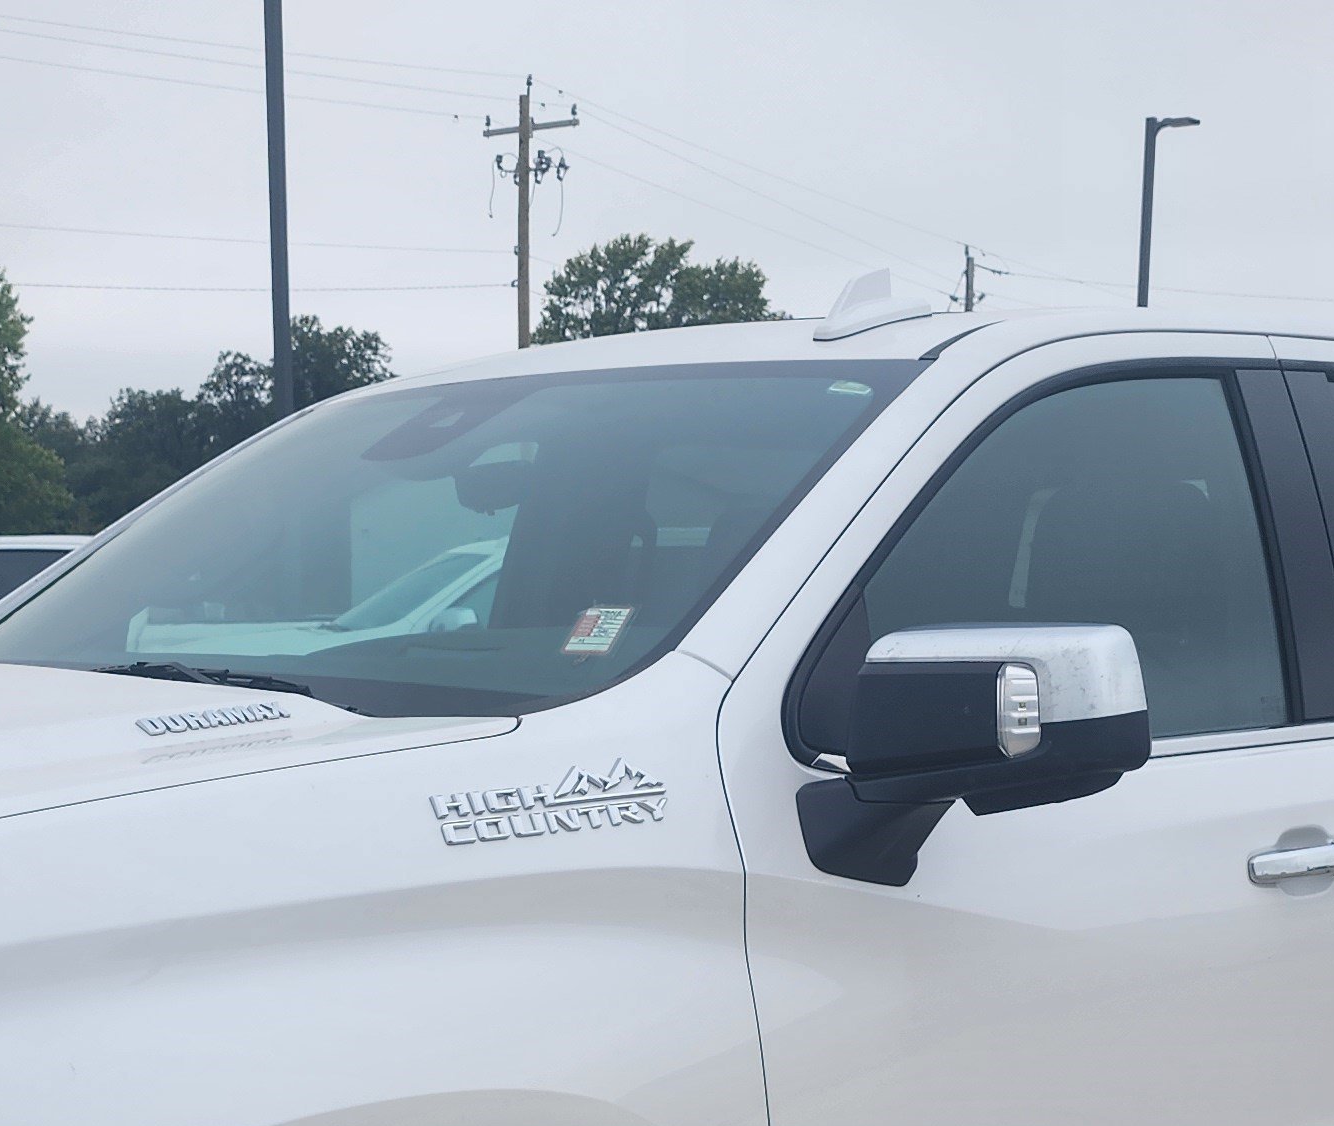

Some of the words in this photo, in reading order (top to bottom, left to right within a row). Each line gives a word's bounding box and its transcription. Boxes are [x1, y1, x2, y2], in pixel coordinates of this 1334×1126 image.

[135, 701, 291, 737] DURAMAX
[429, 784, 551, 820] HIGH
[441, 798, 668, 846] COUNTRY
